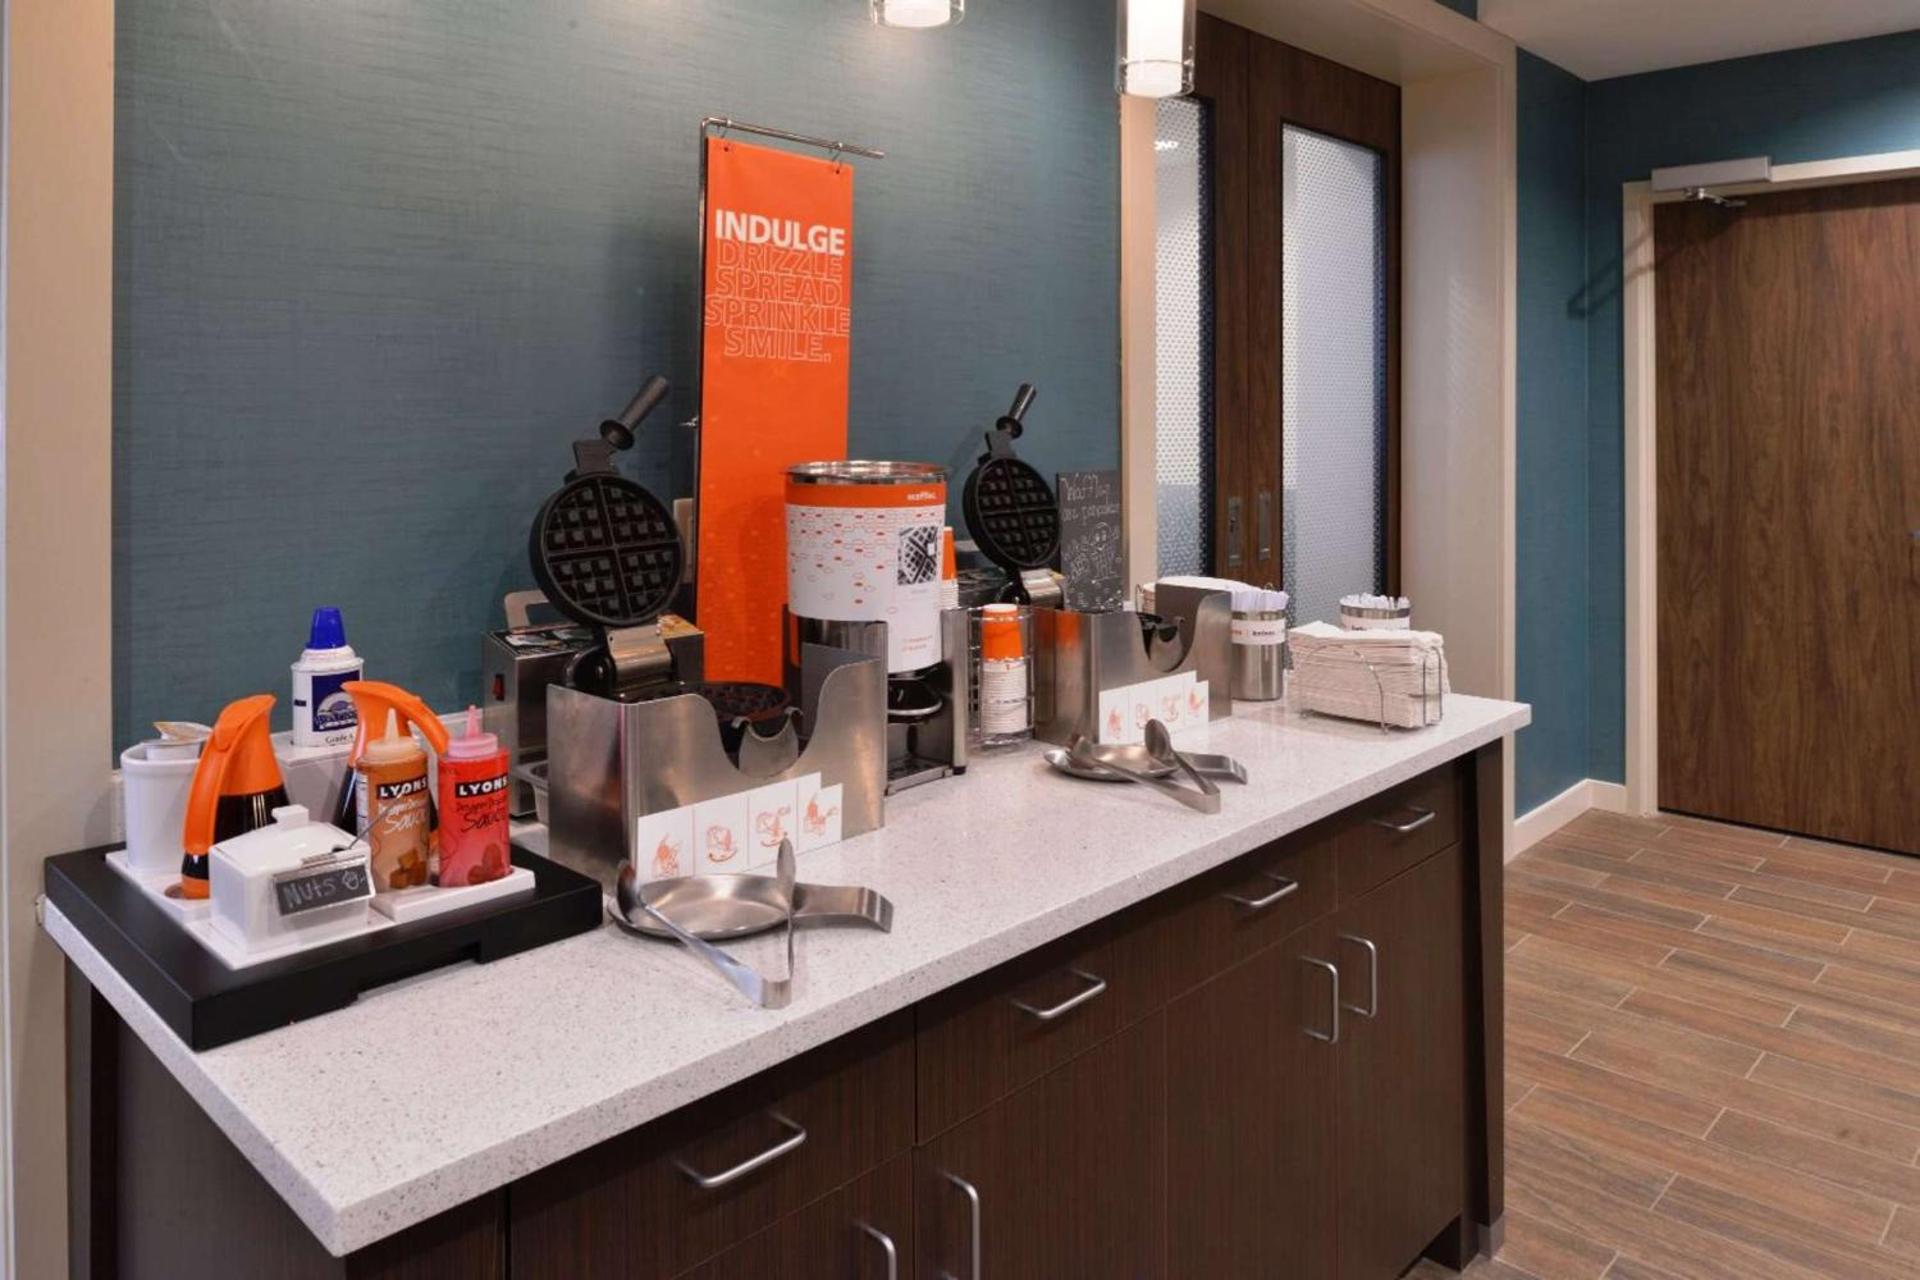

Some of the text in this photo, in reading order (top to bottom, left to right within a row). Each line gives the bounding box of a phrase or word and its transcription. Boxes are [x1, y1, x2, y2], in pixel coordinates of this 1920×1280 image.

[715, 209, 846, 256] INDULGE
[718, 241, 843, 282] DRIZZLE
[715, 267, 843, 307] SPREAD
[704, 295, 851, 337] SPRINKLE
[380, 777, 427, 798] LYONS
[459, 776, 508, 796] LYONS
